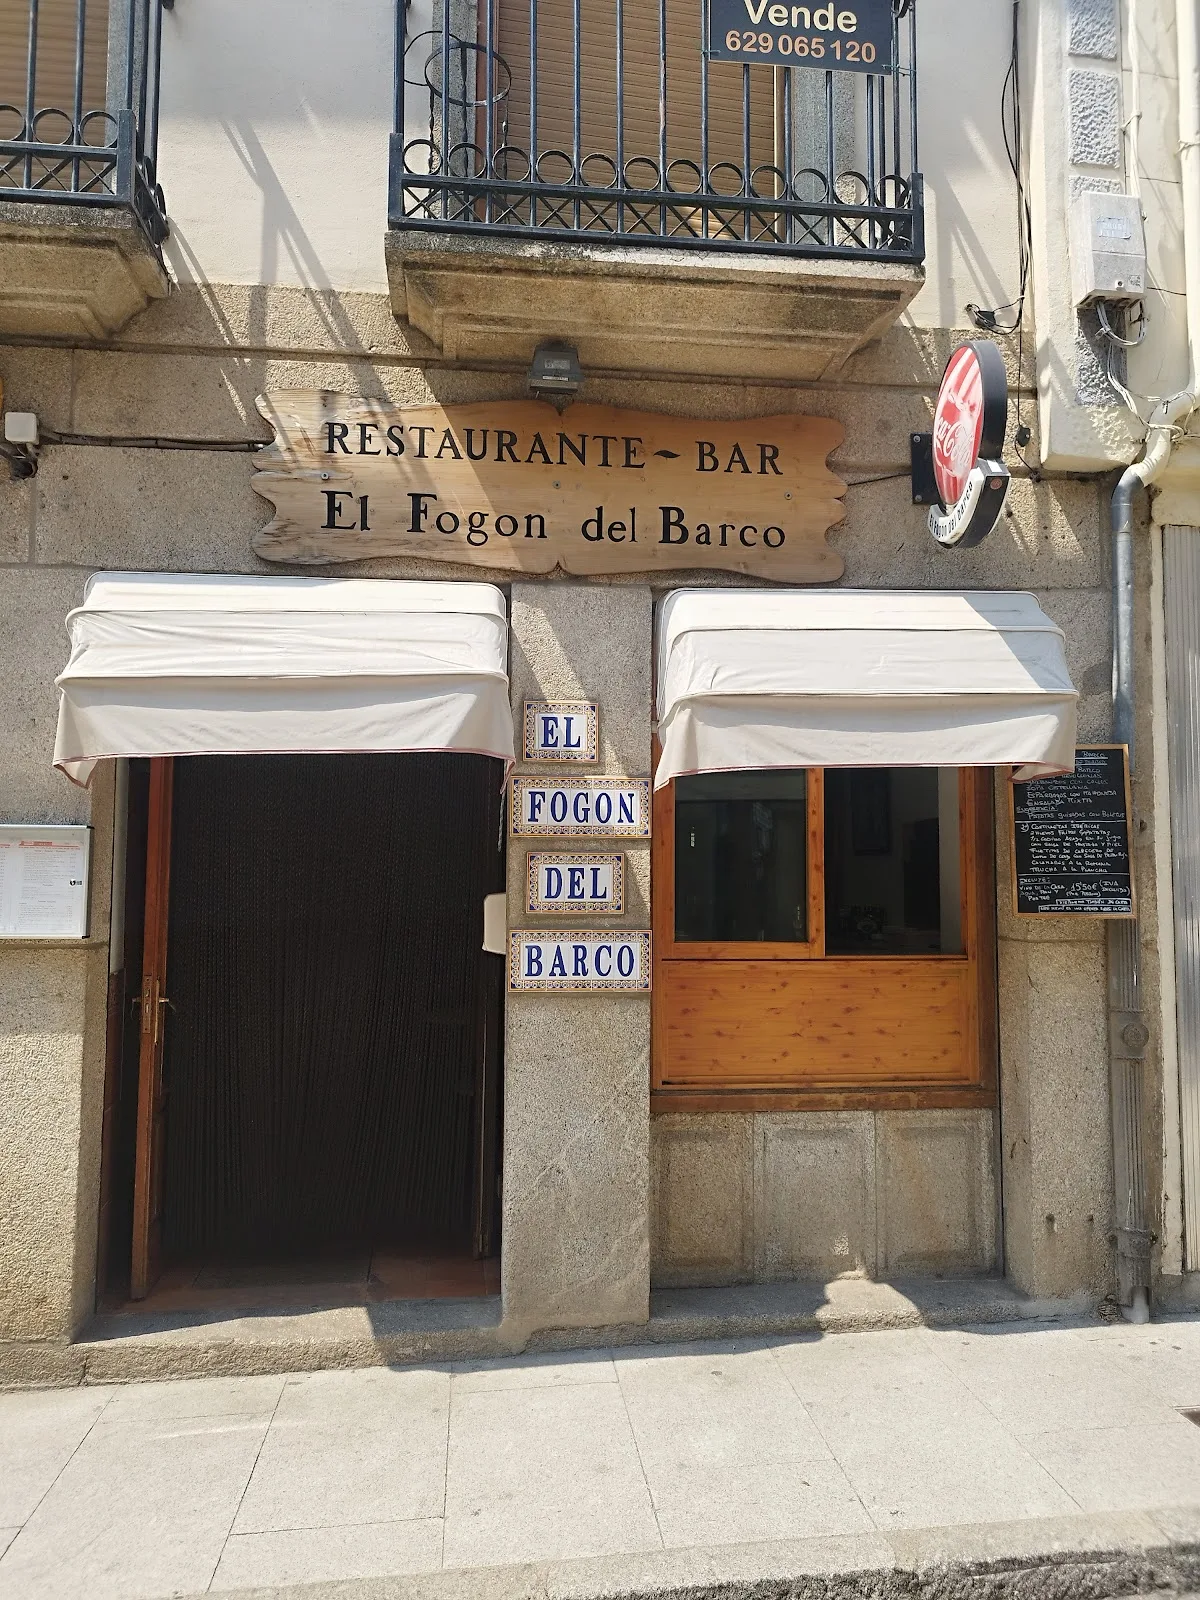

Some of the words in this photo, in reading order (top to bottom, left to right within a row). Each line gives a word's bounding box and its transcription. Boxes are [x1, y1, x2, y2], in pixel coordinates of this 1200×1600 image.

[744, 0, 858, 33] Vende
[725, 30, 774, 54] 629
[778, 34, 825, 59] 065
[829, 40, 876, 64] 120
[325, 420, 647, 470] RESTAURANTE
[695, 440, 784, 476] BAR
[321, 490, 372, 532] El
[406, 491, 548, 547] Fogon
[580, 505, 638, 544] del
[657, 505, 787, 549] Barco
[540, 716, 582, 749] EL
[527, 790, 635, 824] FOGON
[544, 867, 608, 900] DEL
[524, 945, 635, 978] BARCO
